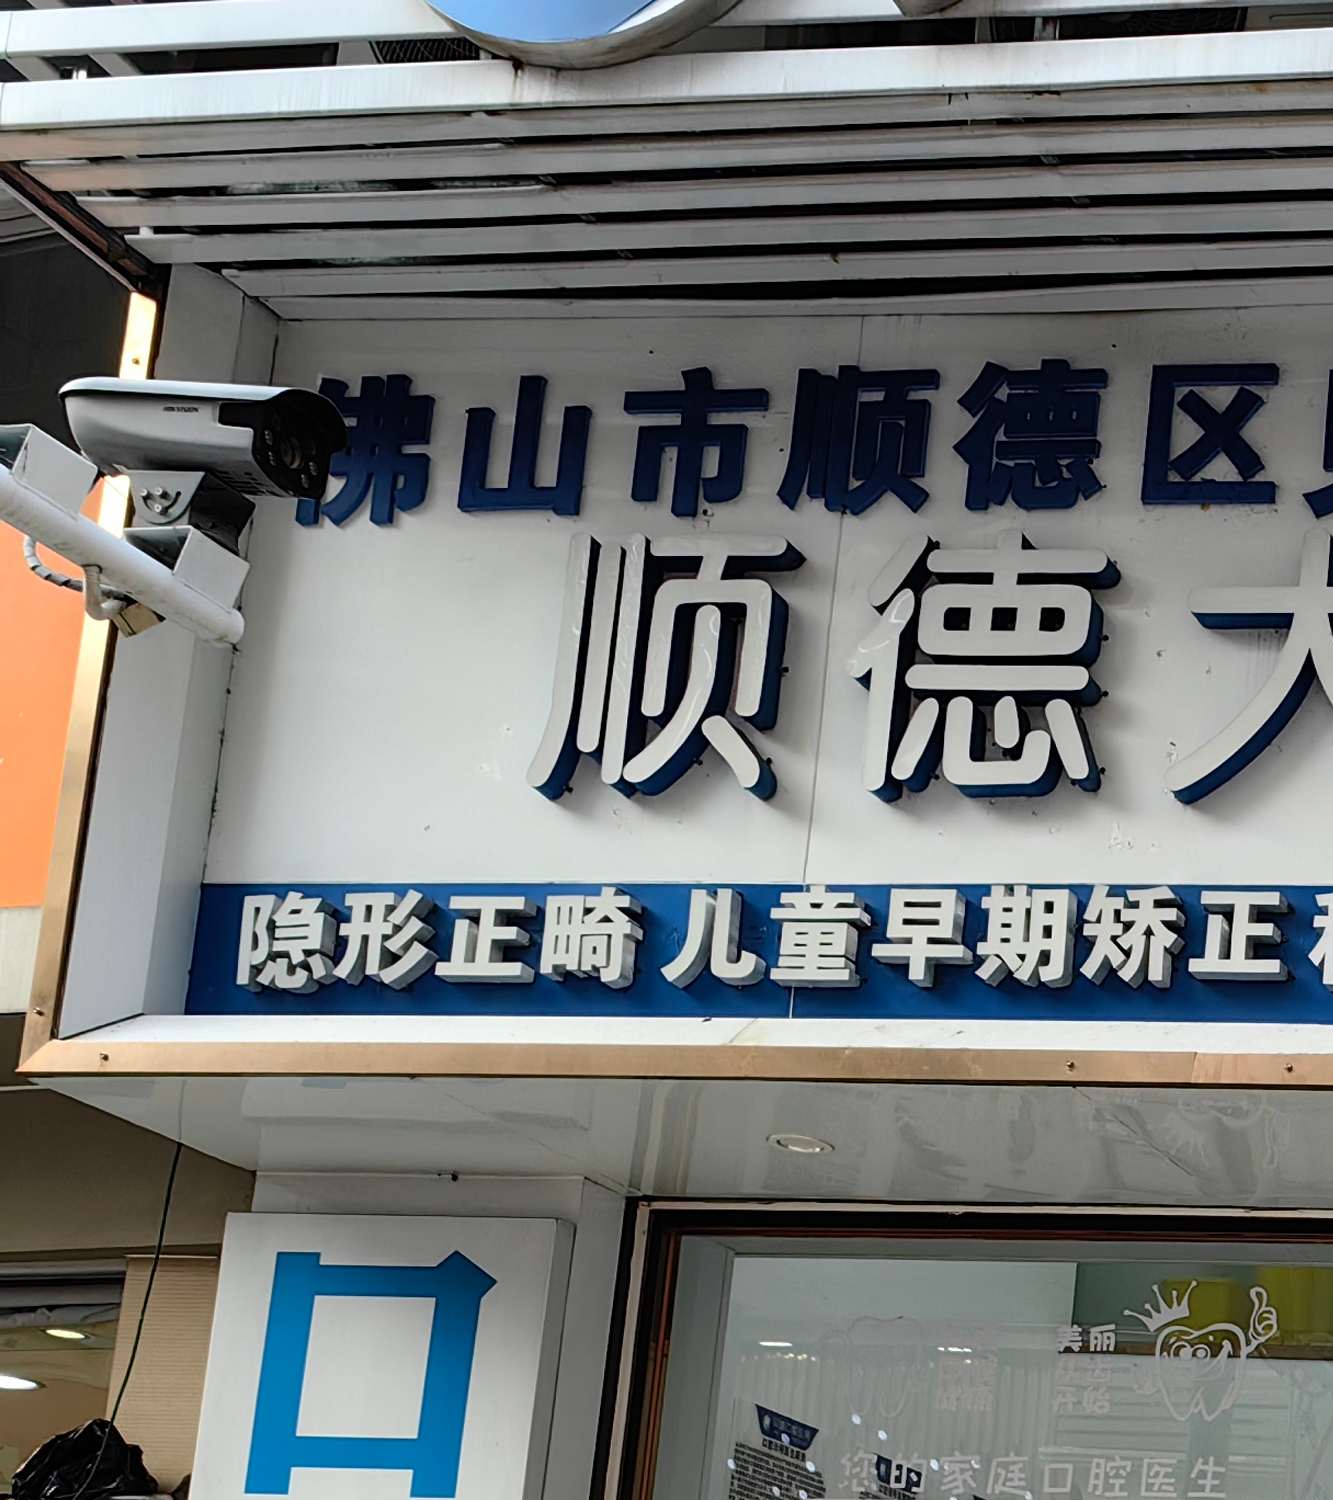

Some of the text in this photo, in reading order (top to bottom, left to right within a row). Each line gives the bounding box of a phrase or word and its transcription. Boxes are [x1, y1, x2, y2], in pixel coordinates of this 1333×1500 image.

[839, 1451, 1227, 1497] 您的家庭口腔医生
